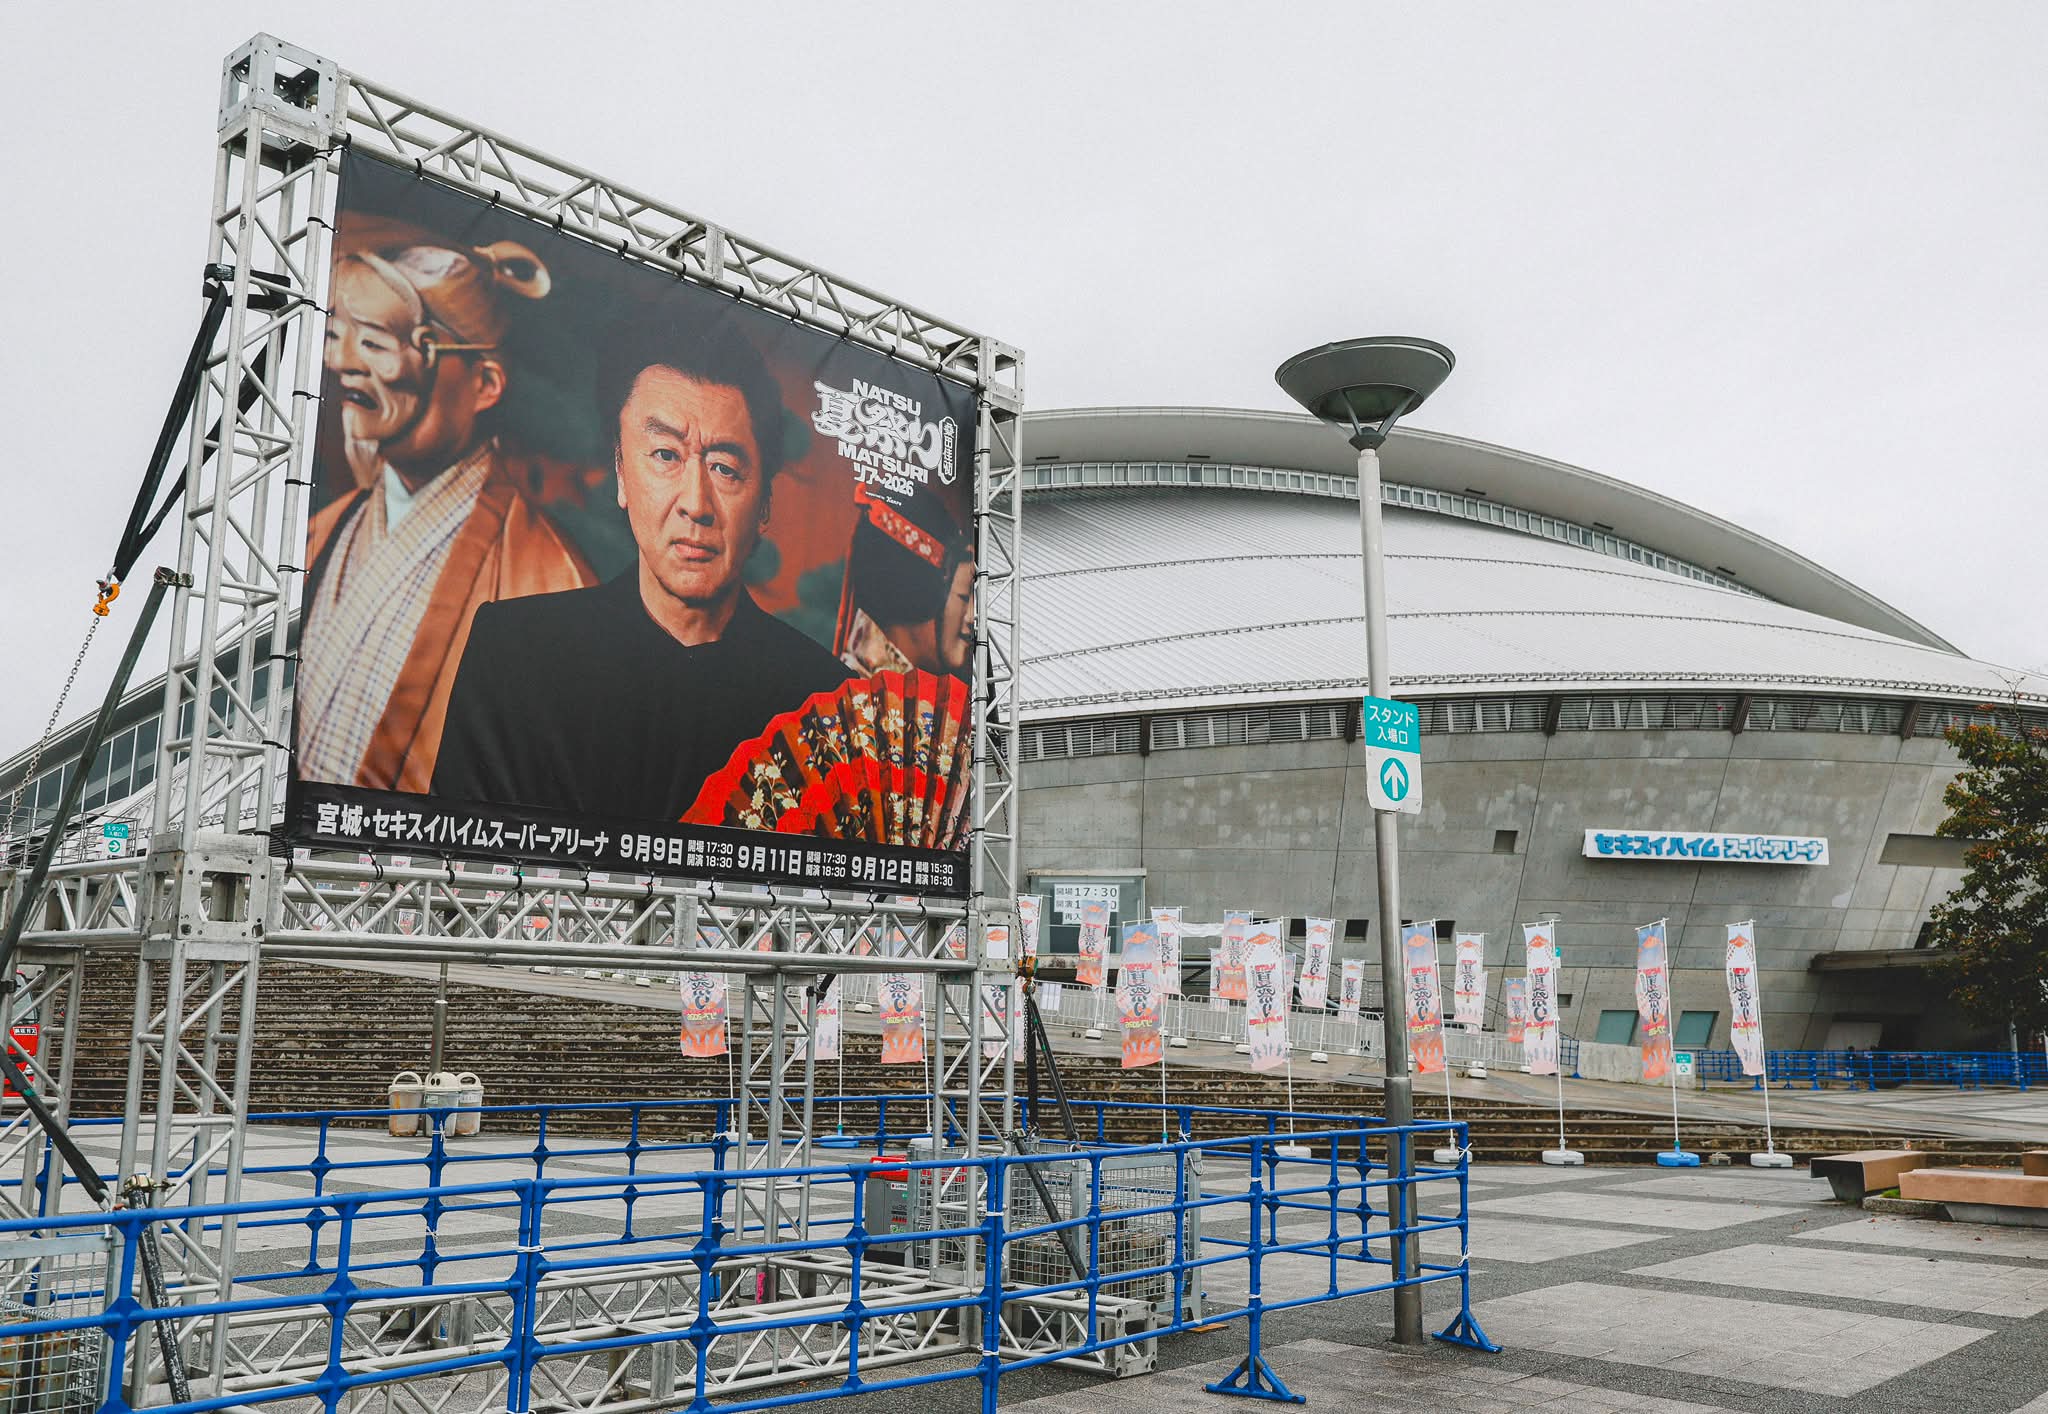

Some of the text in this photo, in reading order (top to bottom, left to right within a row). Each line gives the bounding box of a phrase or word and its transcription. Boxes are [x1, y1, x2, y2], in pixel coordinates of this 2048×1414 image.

[853, 378, 921, 417] NATSU
[838, 440, 928, 484] MATSURI
[1369, 705, 1415, 728] スタンド
[1377, 726, 1408, 745] 入場口
[619, 834, 683, 866] 9月9日
[706, 841, 733, 855] 17:30
[705, 855, 733, 868] 18:30
[737, 845, 802, 875] 9月11日
[822, 852, 847, 865] 17:30
[821, 865, 846, 878] 18:30
[851, 856, 912, 884] 9月12日
[930, 862, 953, 875] 15:30
[929, 874, 953, 887] 16:30
